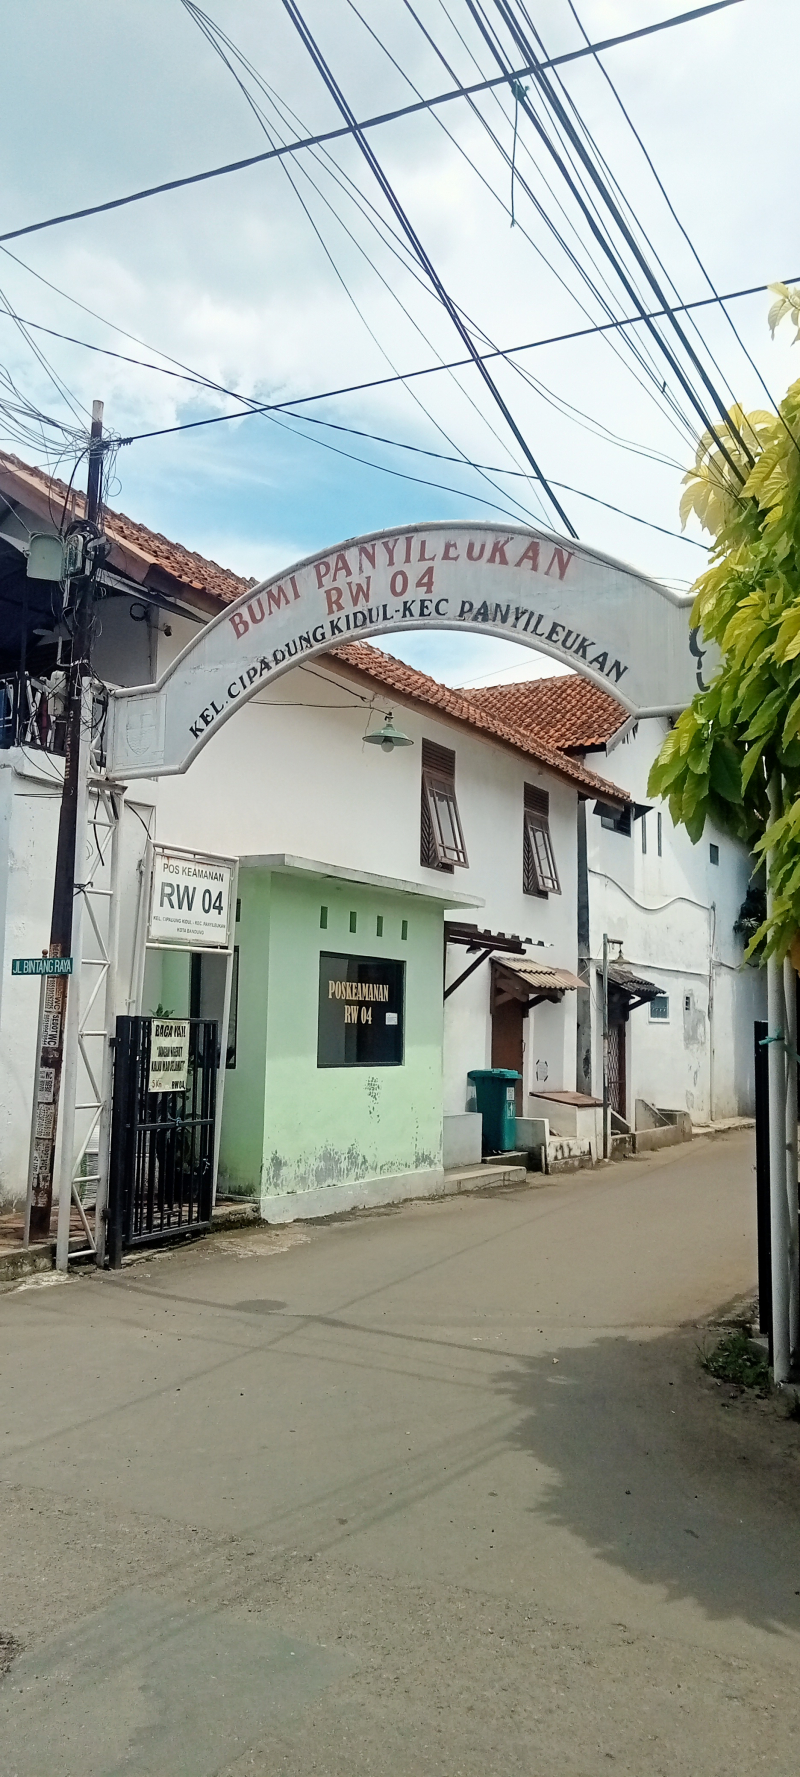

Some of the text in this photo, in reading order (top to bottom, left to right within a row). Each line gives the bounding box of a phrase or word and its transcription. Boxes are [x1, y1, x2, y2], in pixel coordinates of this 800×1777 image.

[229, 535, 575, 639] BUMI PANYILEUKAN
[324, 565, 435, 616] RW 04
[458, 600, 629, 683] PANYILEUKAN
[163, 863, 224, 882] POS KEAMANAN
[160, 882, 223, 915] RW 04
[13, 959, 71, 974] JL BINTANG RAYA
[344, 1005, 359, 1024] RW
[361, 1006, 372, 1025] 04
[47, 1032, 59, 1046] WC
[155, 1024, 173, 1037] BACA
